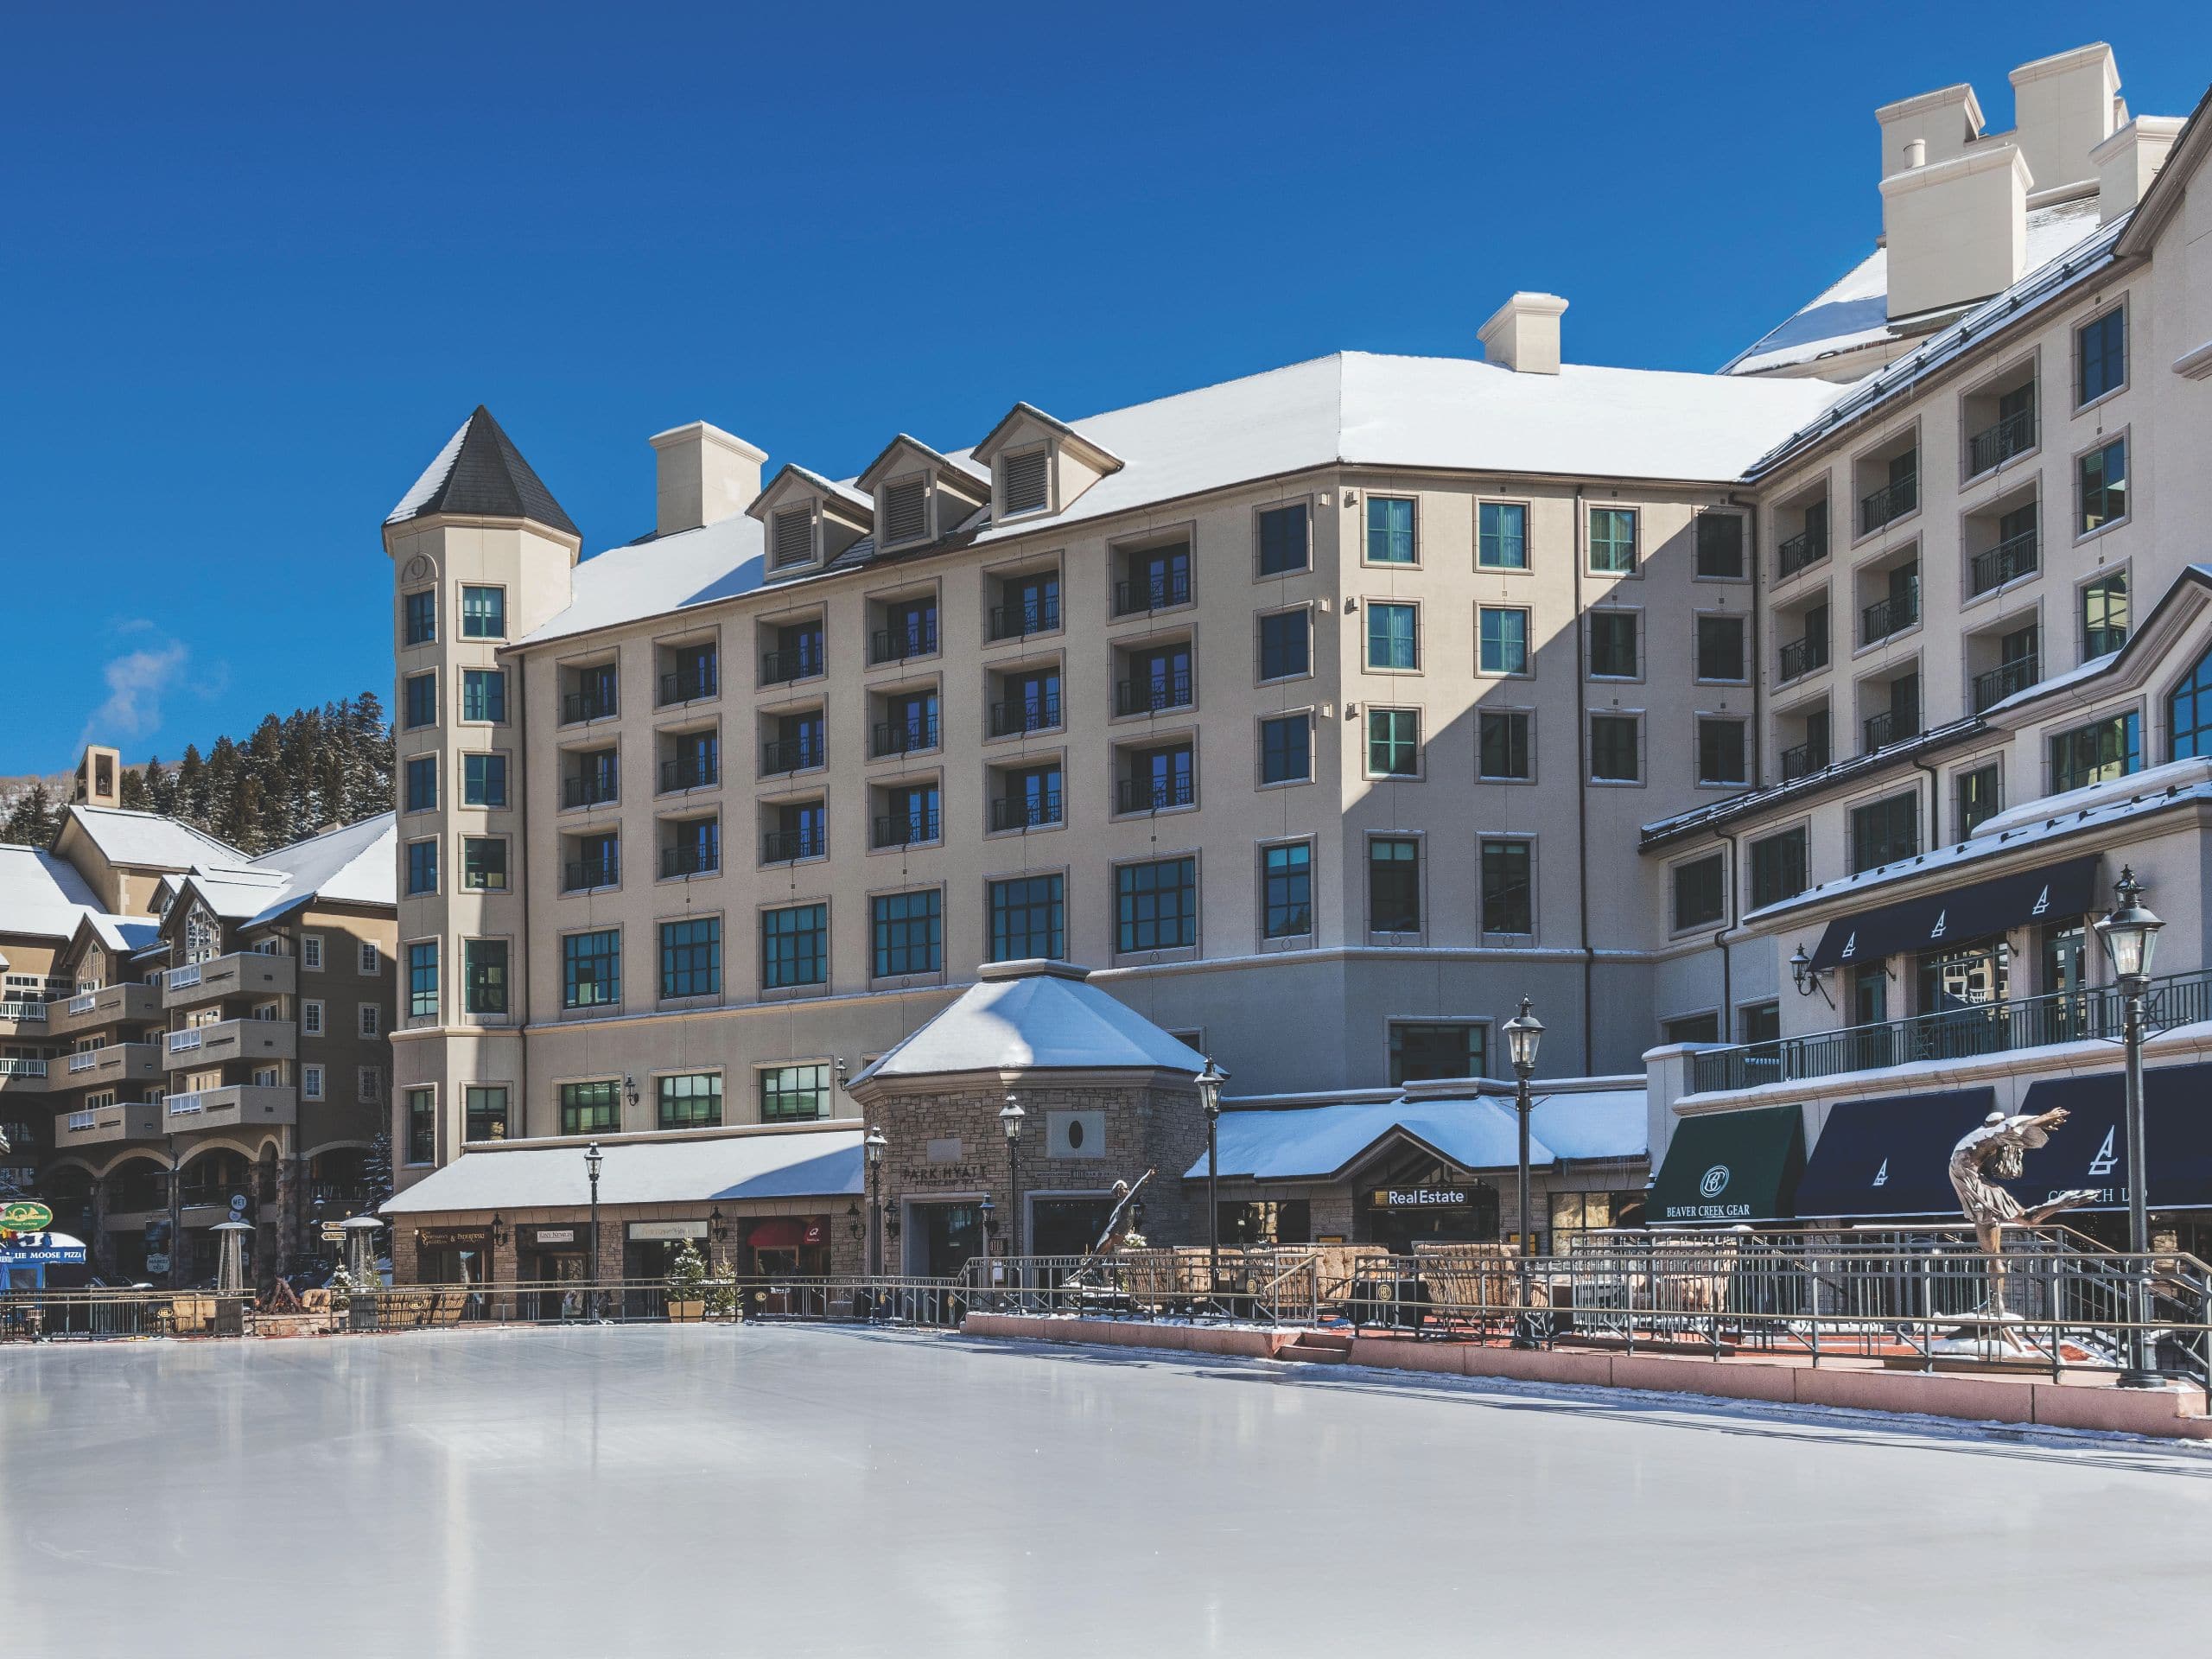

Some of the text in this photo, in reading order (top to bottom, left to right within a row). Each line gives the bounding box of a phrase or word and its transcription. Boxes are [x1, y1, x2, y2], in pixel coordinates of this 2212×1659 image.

[902, 1166, 986, 1179] PARK HYATT
[1389, 1190, 1465, 1205] Real Estate
[1667, 1204, 1751, 1217] BEAVER CREEK GEAR
